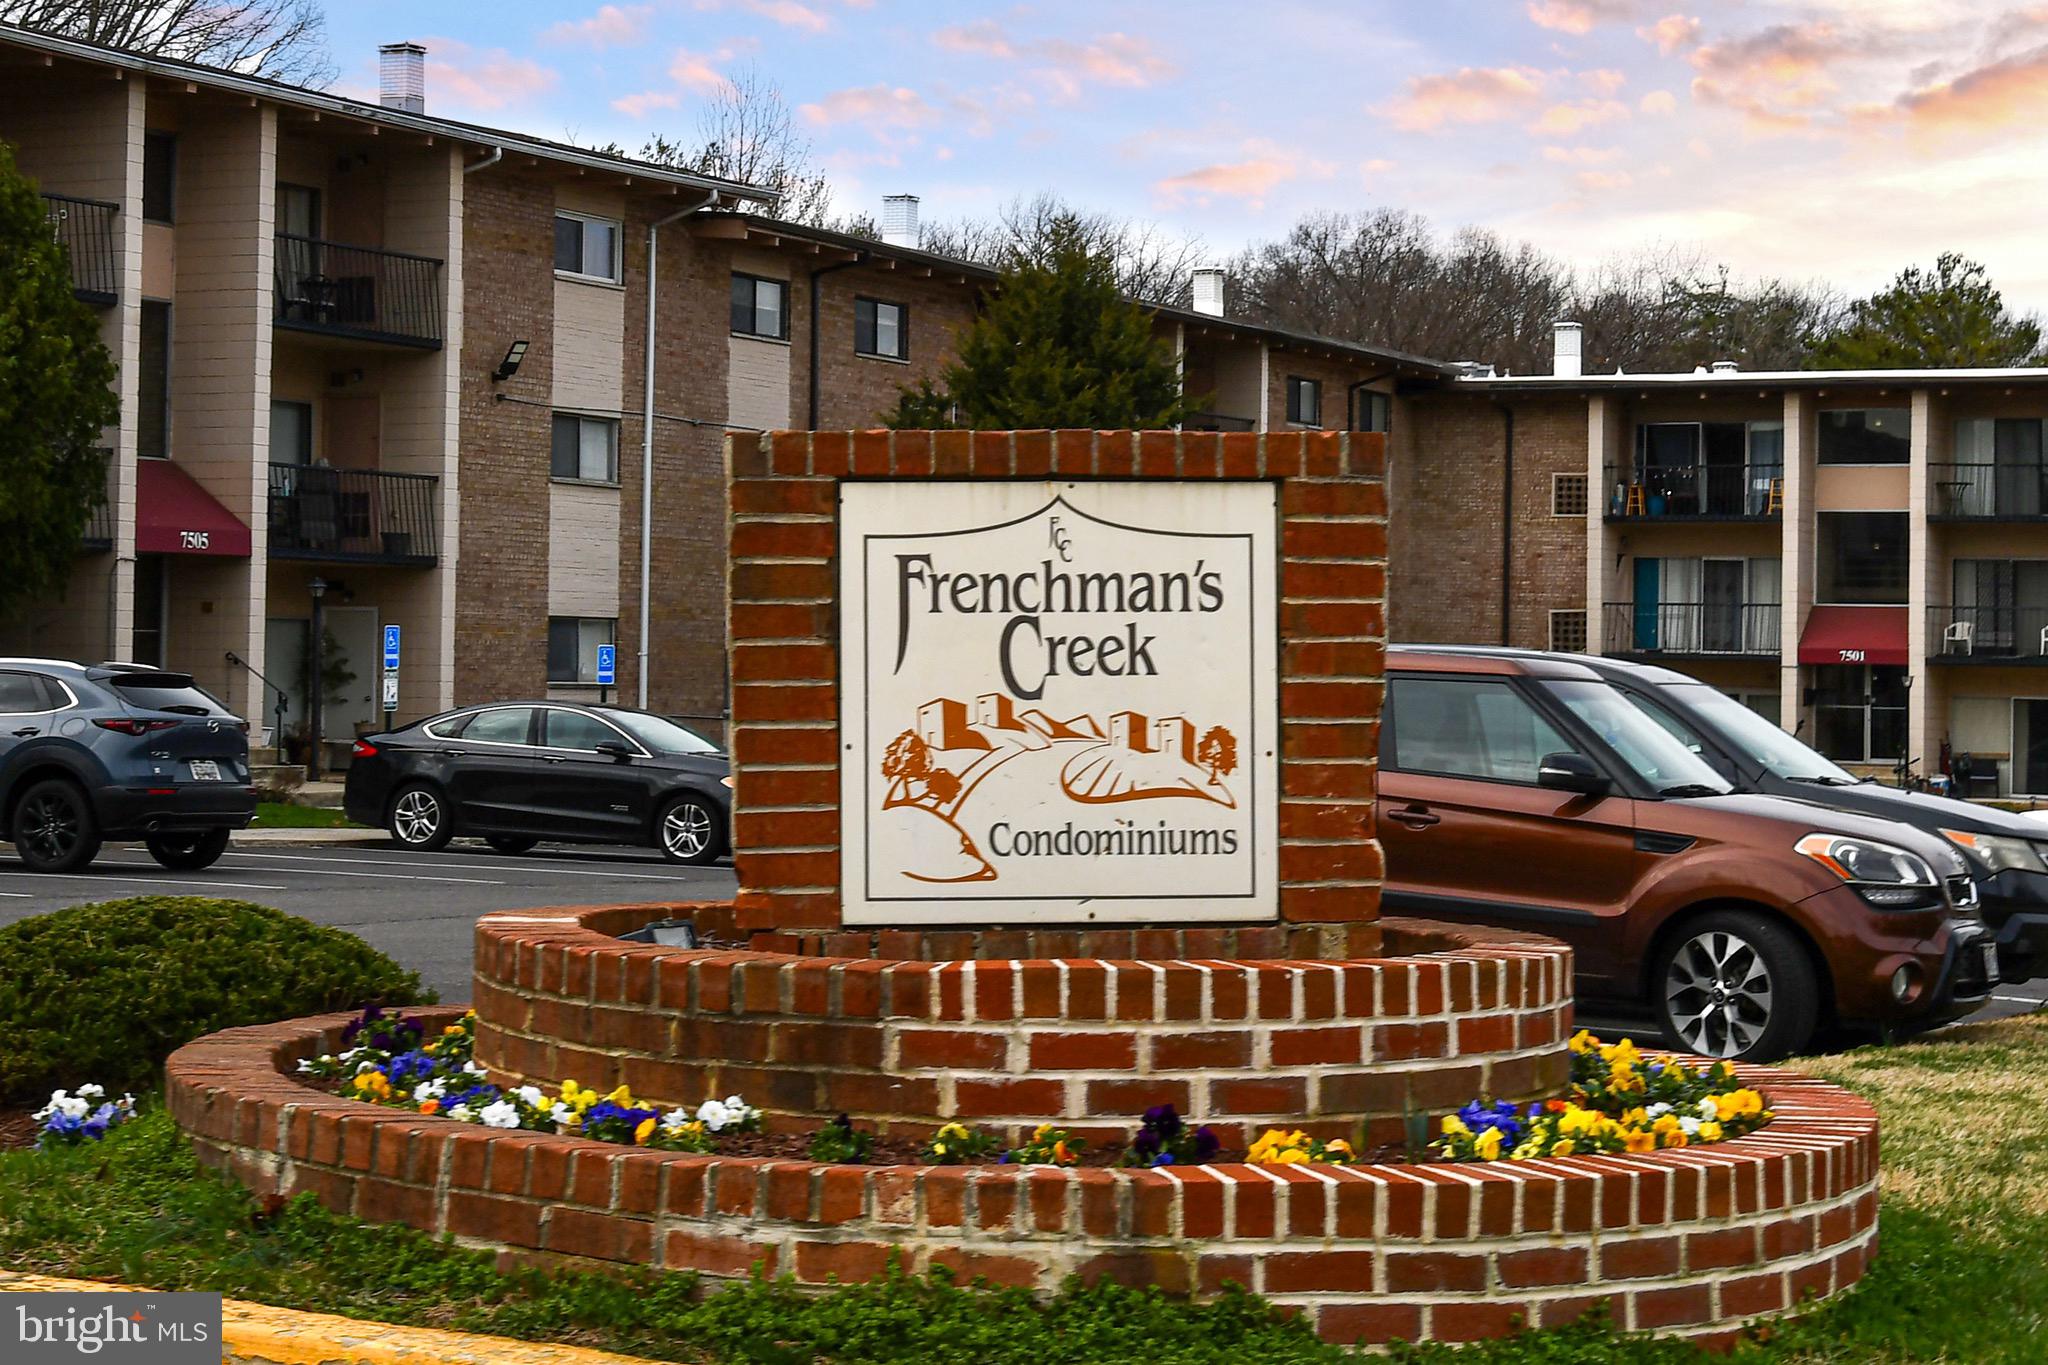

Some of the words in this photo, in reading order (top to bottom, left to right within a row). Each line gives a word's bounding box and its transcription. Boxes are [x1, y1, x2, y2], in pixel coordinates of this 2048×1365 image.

[179, 531, 209, 549] 7505
[893, 553, 1224, 675] Frenchman's
[1000, 615, 1159, 700] Creek
[1838, 650, 1865, 662] 7501
[988, 819, 1238, 857] Condominiums
